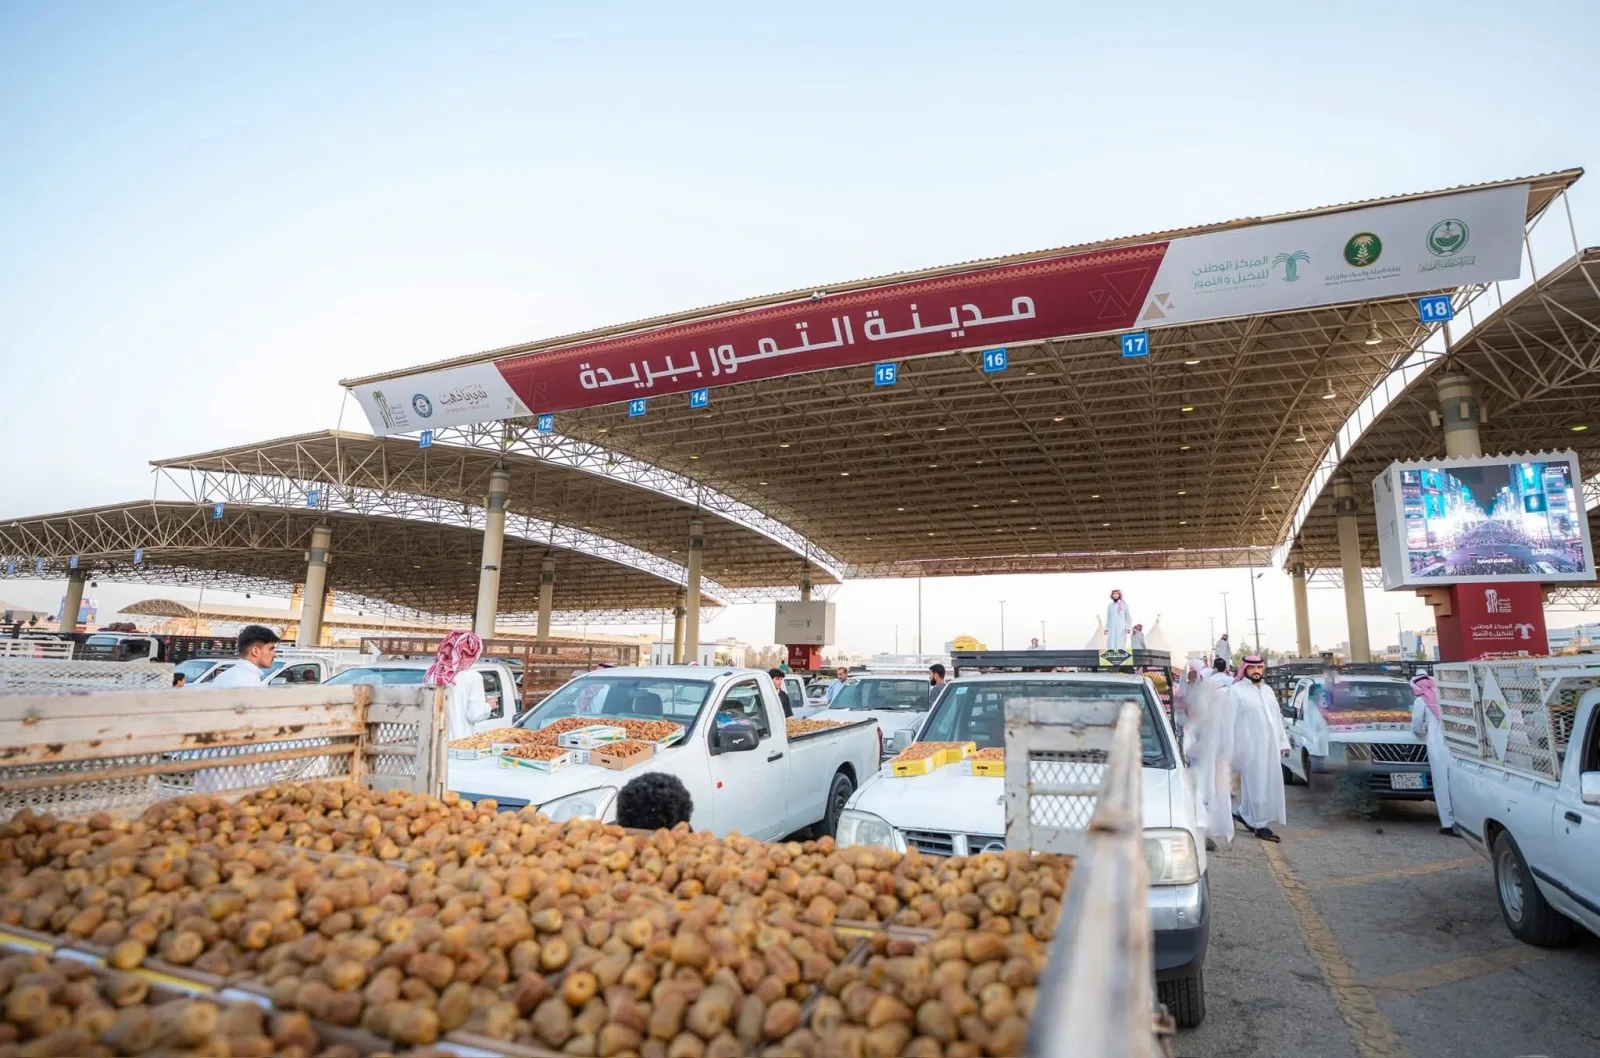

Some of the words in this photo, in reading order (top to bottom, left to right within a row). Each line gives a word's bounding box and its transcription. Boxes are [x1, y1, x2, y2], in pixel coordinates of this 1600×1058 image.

[1192, 260, 1232, 277] الوطني
[1234, 255, 1268, 271] المركز
[1194, 275, 1222, 290] التمور
[1232, 269, 1269, 284] للنخيل
[1423, 302, 1447, 317] 18
[864, 296, 1036, 341] مدينة
[708, 315, 855, 377] التمور
[1125, 338, 1144, 352] 17
[986, 353, 1004, 368] 16
[579, 351, 703, 390] ببريدة
[877, 368, 894, 381] 15
[693, 390, 706, 404] 14
[632, 400, 644, 412] 13
[540, 417, 551, 430] 12
[421, 434, 430, 445] 11
[309, 493, 317, 505] 10
[216, 506, 222, 516] 9
